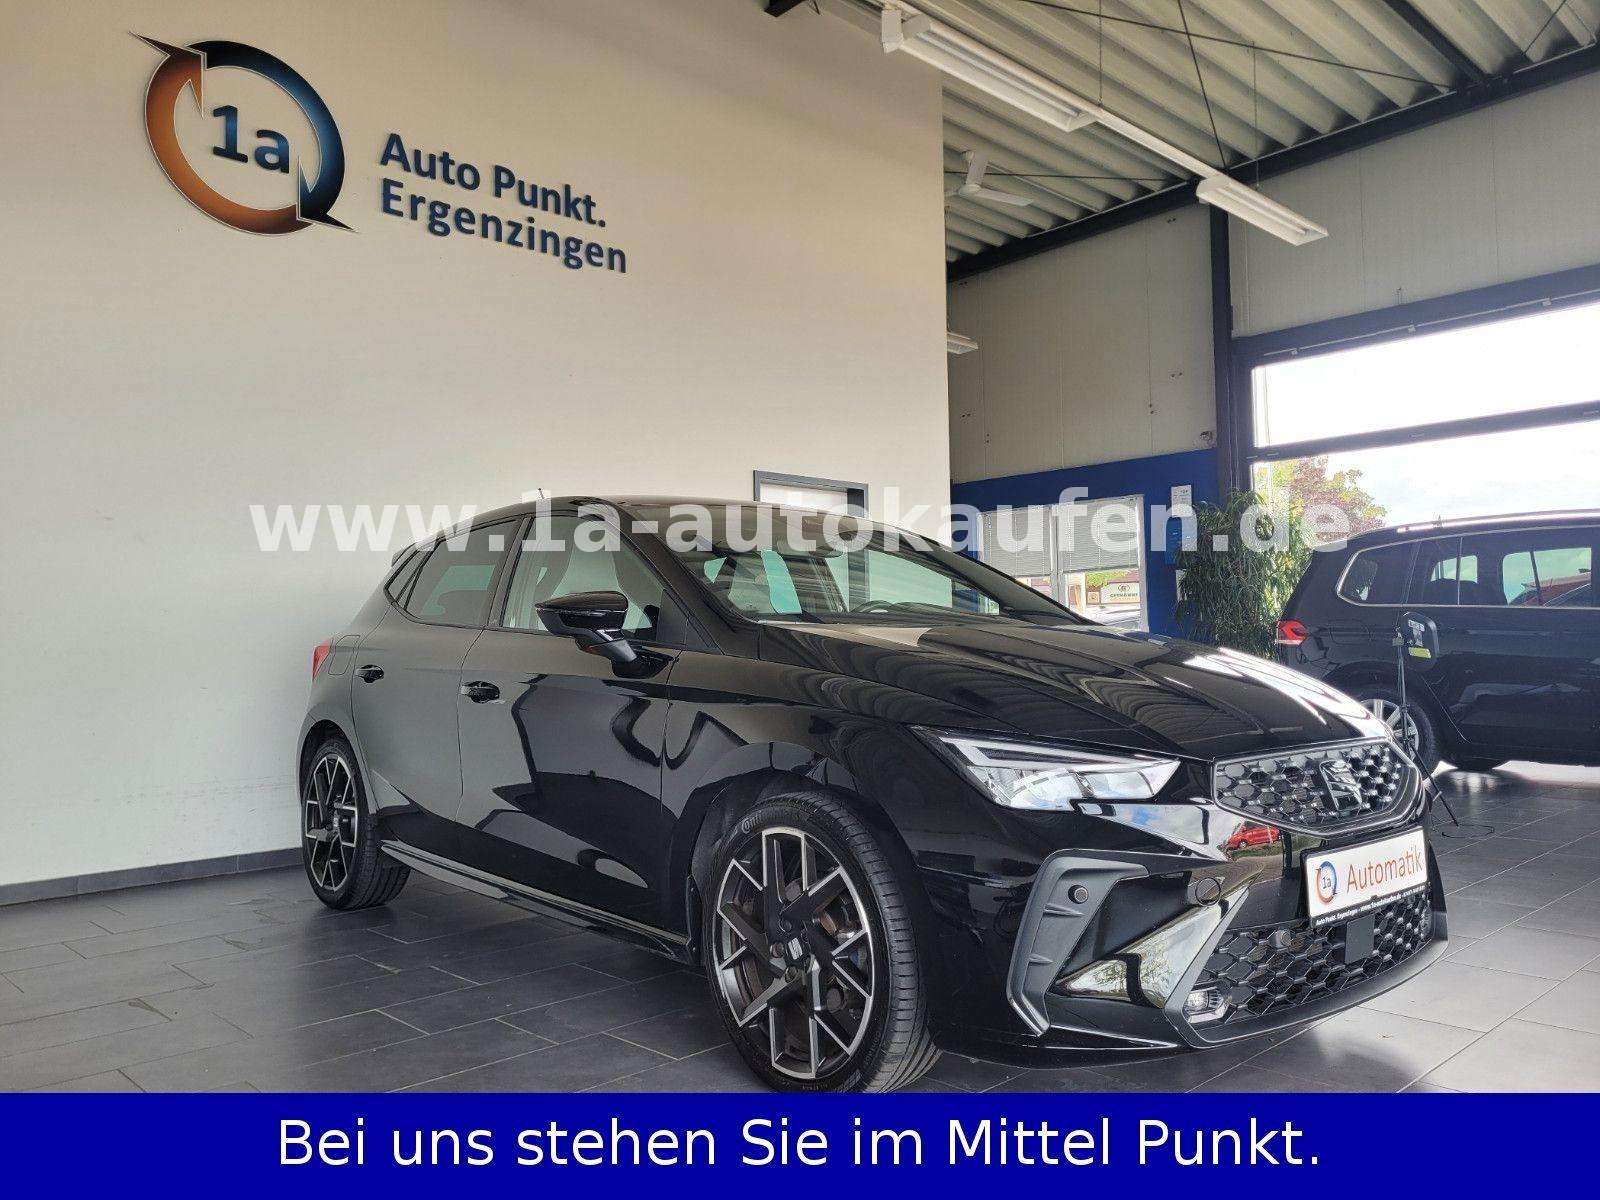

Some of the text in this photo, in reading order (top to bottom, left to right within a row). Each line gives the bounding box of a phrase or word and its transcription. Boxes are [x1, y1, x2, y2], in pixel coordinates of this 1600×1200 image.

[211, 104, 290, 175] 1a
[380, 132, 607, 228] Auto Punkt.
[380, 177, 627, 274] Ergenzingen
[1321, 874, 1332, 890] 1a
[1346, 845, 1423, 893] Automatik
